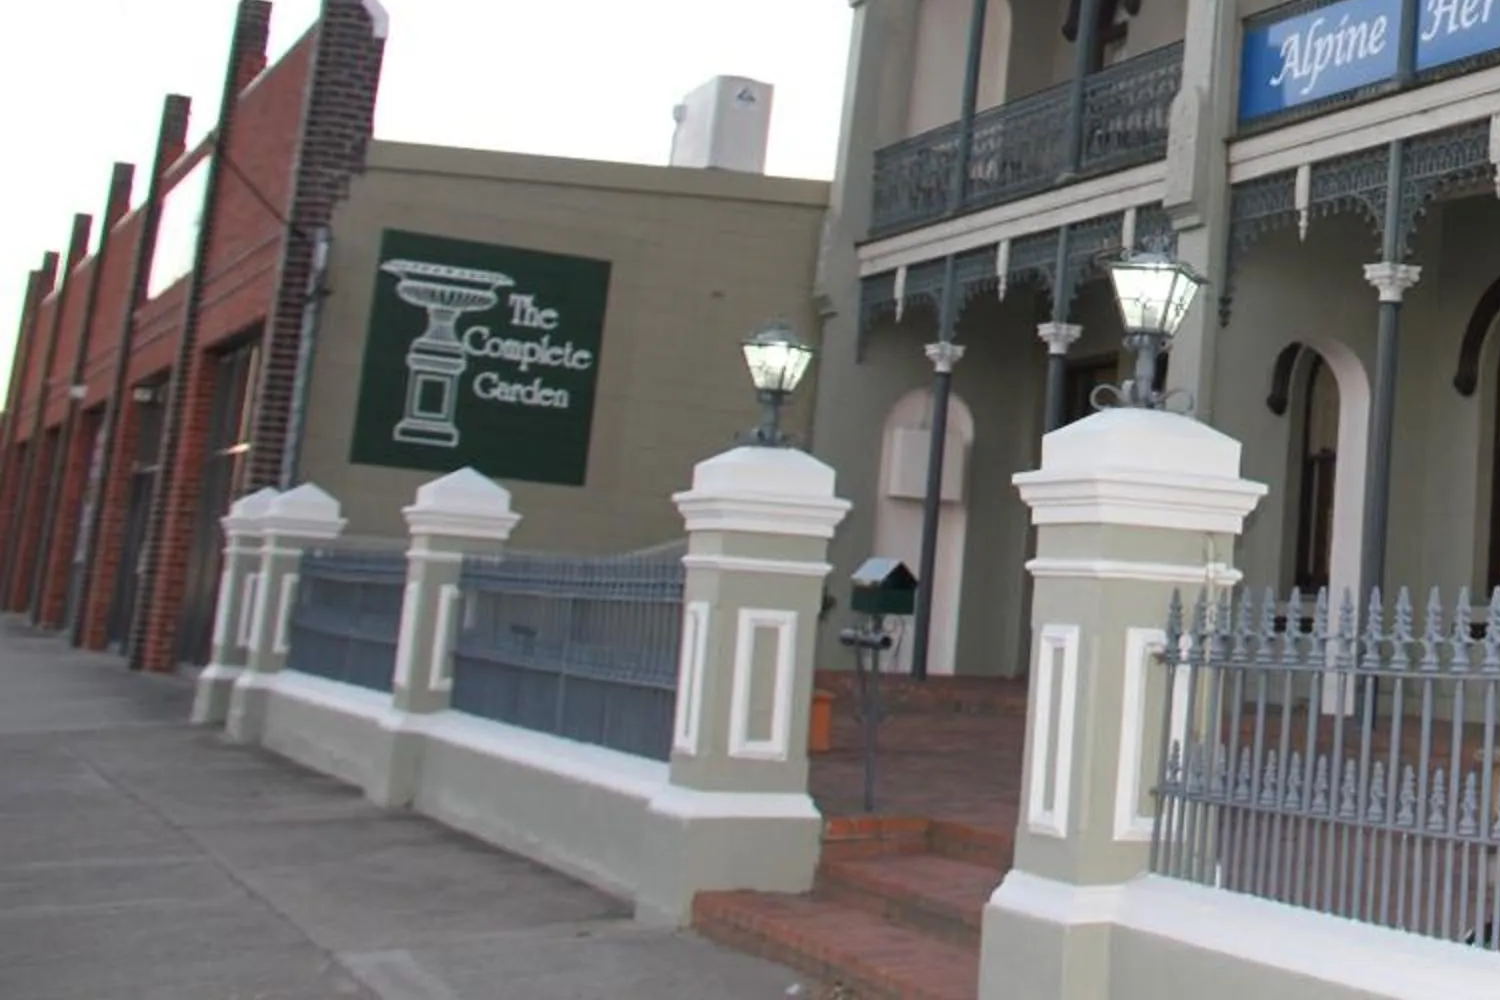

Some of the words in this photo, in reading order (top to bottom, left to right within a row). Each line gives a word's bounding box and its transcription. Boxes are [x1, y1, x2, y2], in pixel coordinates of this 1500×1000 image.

[1269, 9, 1389, 95] Alpine
[508, 293, 559, 329] The
[463, 326, 593, 372] Complete
[472, 372, 570, 409] Garden
